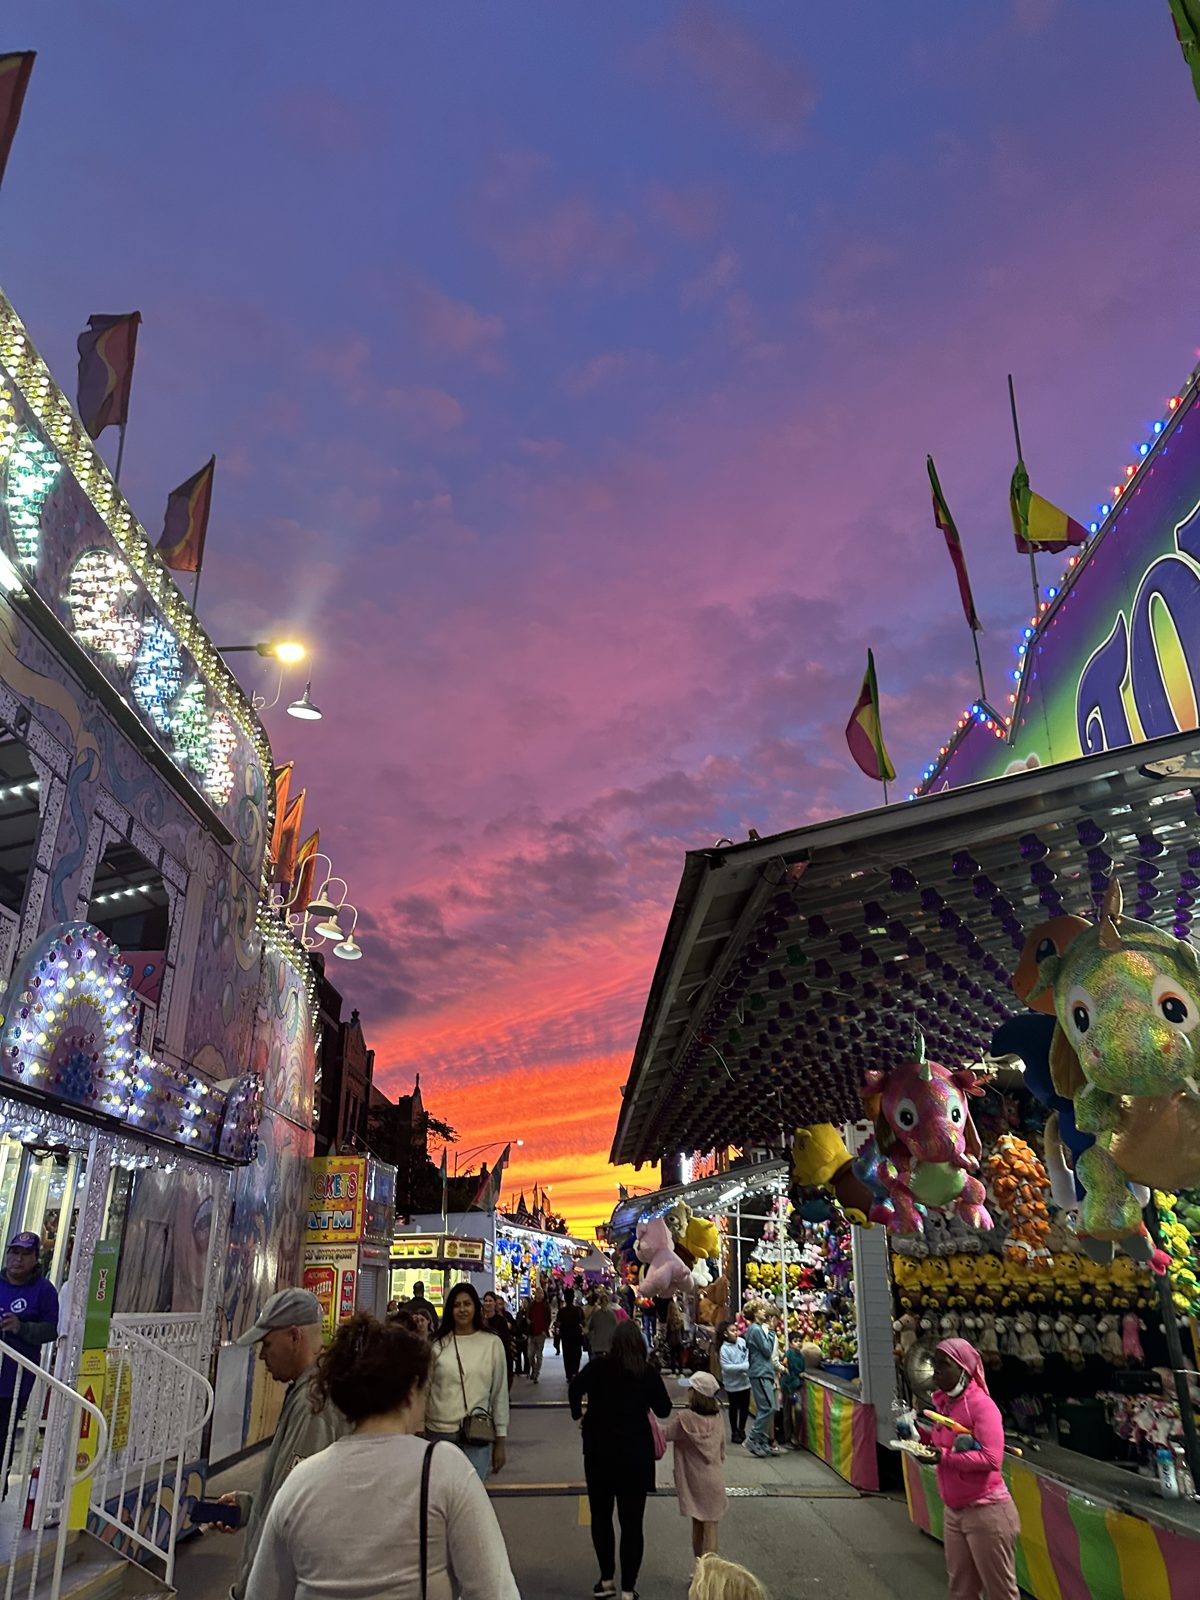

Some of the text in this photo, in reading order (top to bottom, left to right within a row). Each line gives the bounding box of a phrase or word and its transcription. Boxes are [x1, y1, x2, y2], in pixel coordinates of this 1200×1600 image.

[307, 1210, 353, 1230] ATM
[96, 1268, 108, 1301] YES
[341, 1271, 354, 1311] ATM
